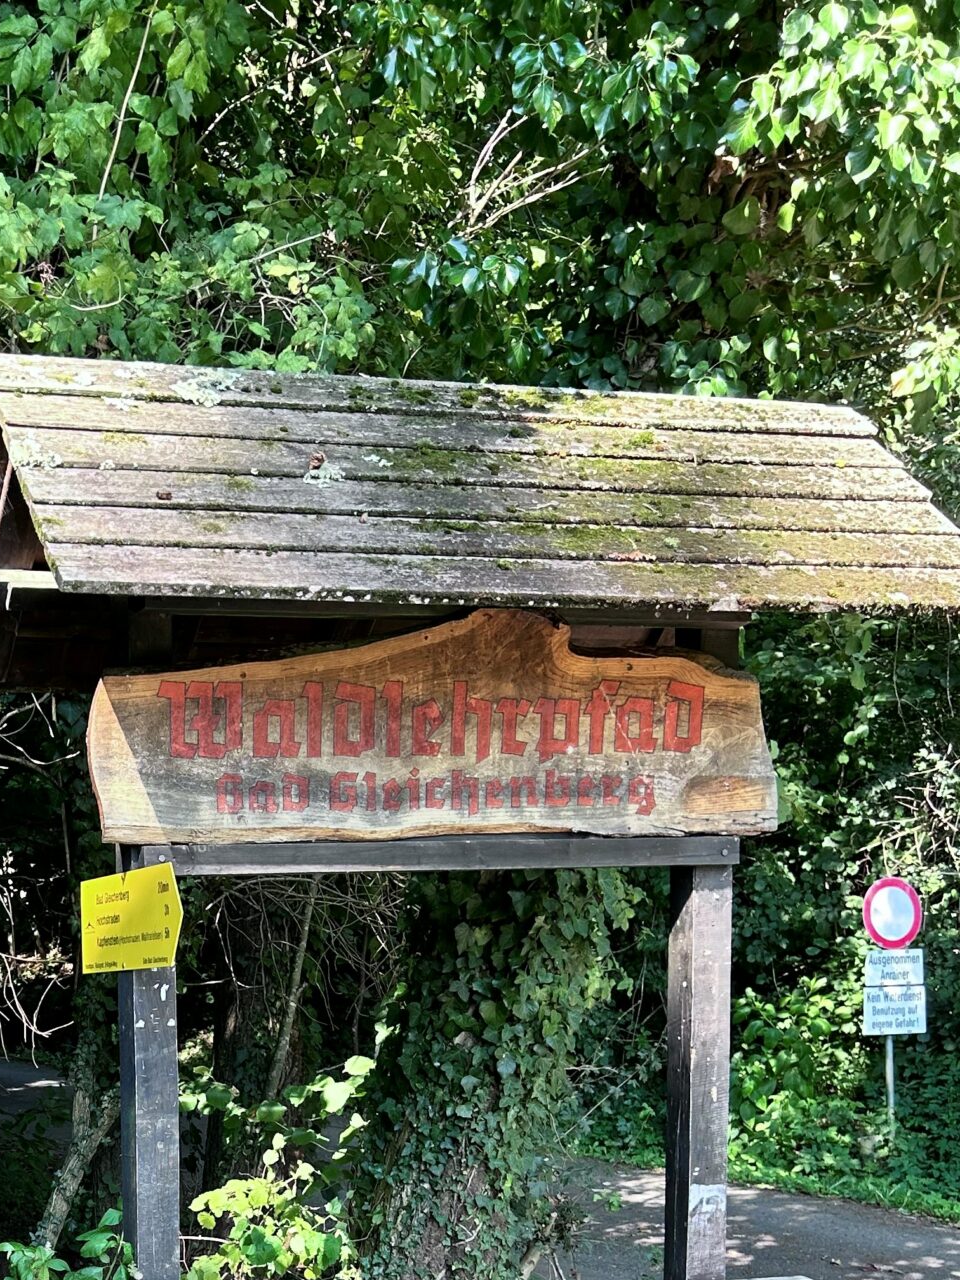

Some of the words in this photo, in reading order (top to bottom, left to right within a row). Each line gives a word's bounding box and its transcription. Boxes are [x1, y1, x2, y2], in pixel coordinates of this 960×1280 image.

[157, 680, 704, 762] Waldlehrpfad
[216, 773, 310, 815] Bad
[328, 767, 656, 816] Gleichenberg
[869, 954, 920, 968] Ausgenommen
